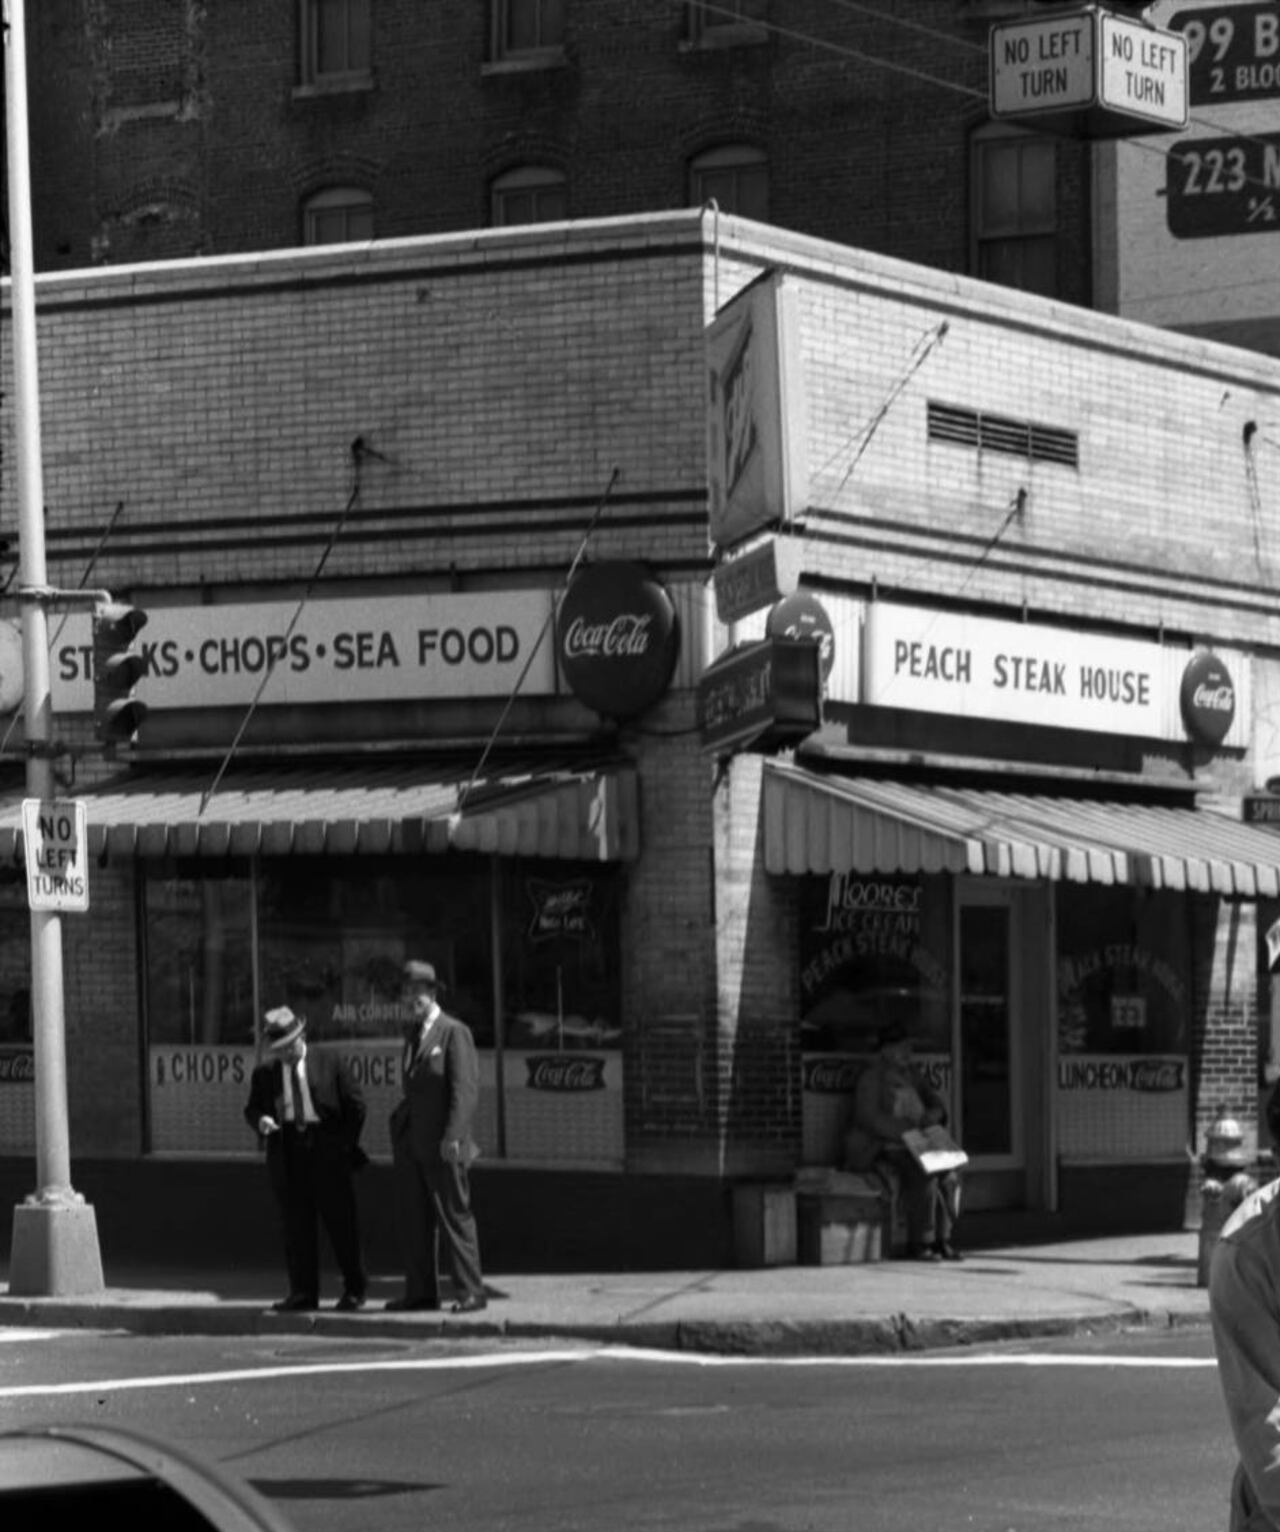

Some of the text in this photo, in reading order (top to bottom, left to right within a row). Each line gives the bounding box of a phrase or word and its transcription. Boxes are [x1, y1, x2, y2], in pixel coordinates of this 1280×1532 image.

[1005, 29, 1081, 66] NO LEFT
[1112, 31, 1177, 74] NO LEFT
[1020, 67, 1067, 98] TURN
[1125, 71, 1166, 106] TURN
[1210, 68, 1226, 92] 2
[1182, 147, 1246, 195] 223
[58, 625, 521, 681] STKS CHOPS SEA FOOD
[894, 639, 1150, 706] PEACH STEAK HOUSE
[40, 815, 72, 842] NO
[35, 847, 78, 869] LEFT
[33, 875, 85, 896] TURNS
[171, 1052, 396, 1087] CHOPS OICE
[1058, 1062, 1129, 1090] LUNCHEON
